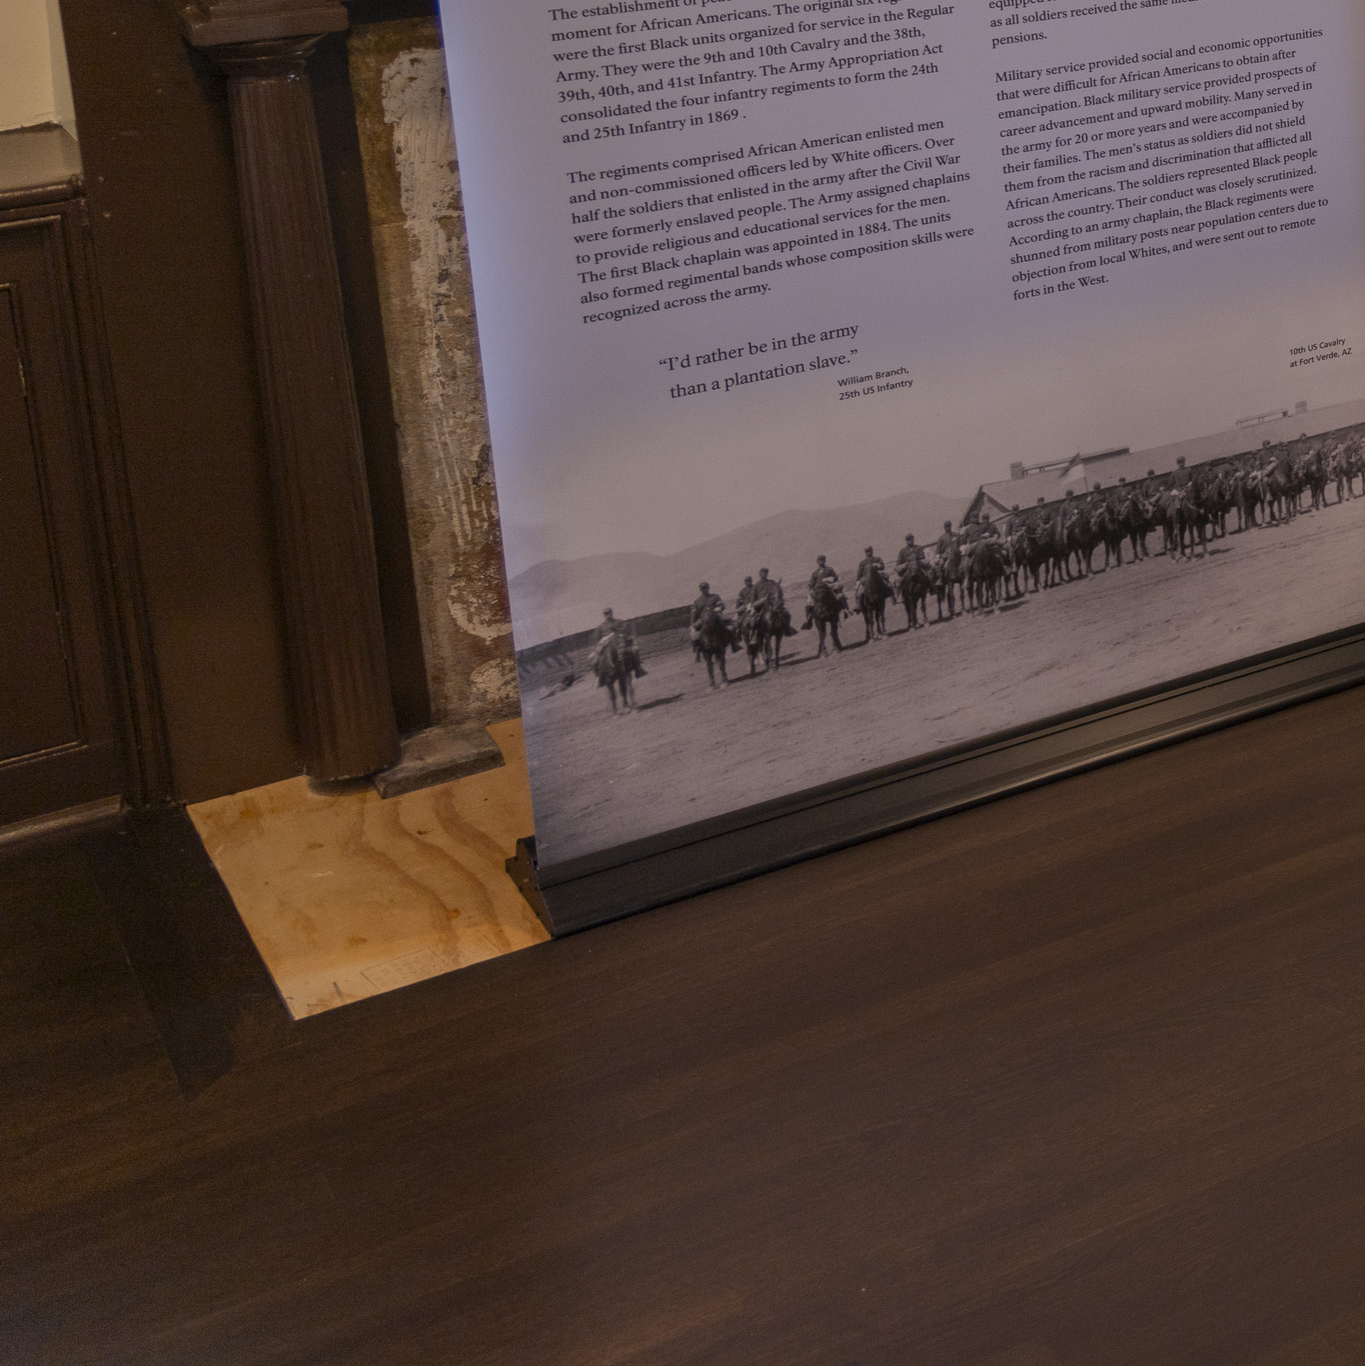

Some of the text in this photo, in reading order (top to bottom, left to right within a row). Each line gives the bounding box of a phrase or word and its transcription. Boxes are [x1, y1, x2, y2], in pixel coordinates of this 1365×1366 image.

[1289, 337, 1347, 356] 10th US Cavalry
